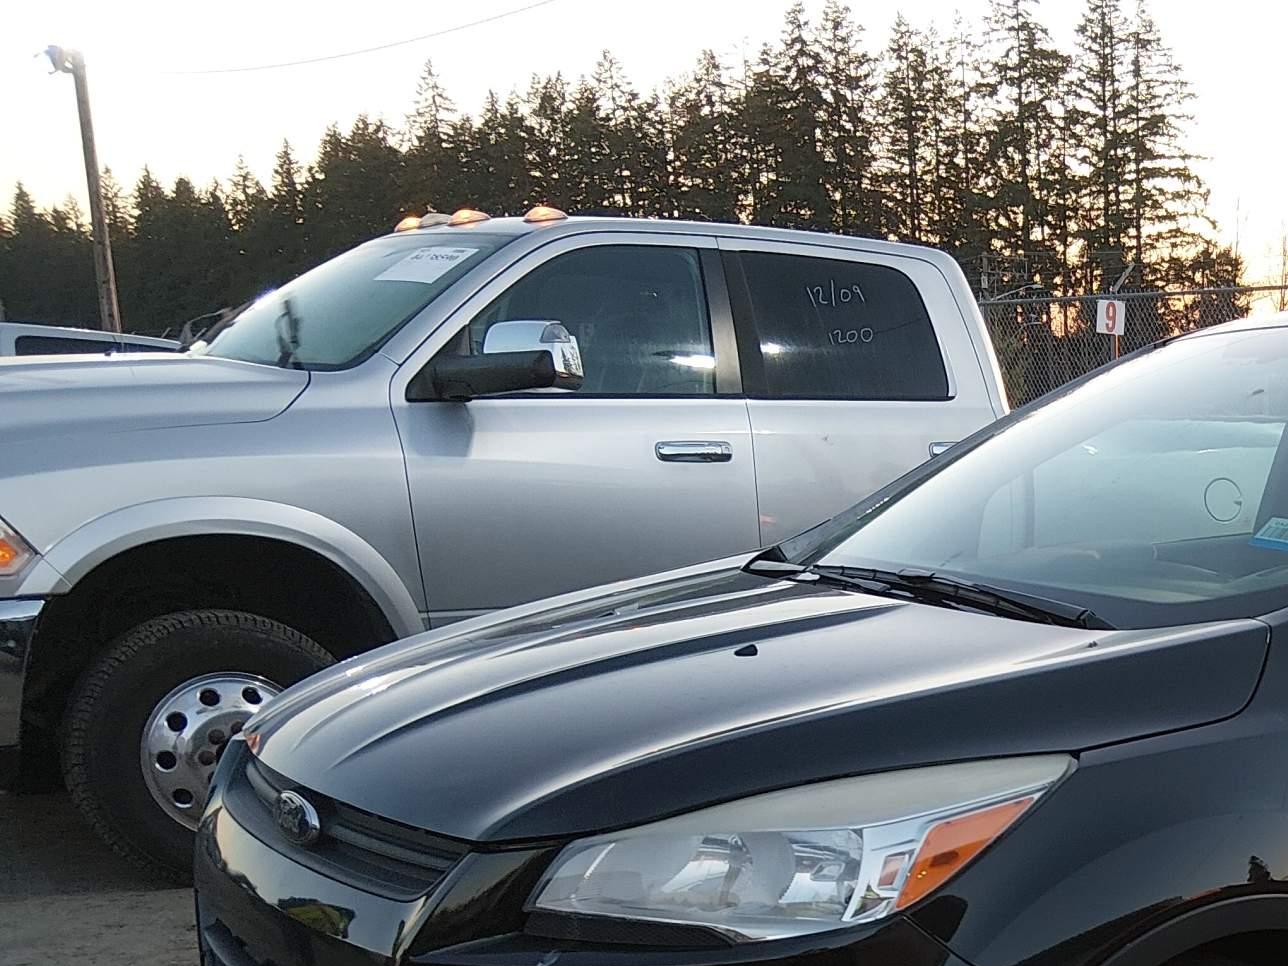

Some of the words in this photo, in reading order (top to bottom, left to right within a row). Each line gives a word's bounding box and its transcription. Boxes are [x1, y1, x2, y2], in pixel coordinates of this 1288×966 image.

[806, 279, 865, 308] 12/09
[1105, 301, 1118, 332] 9
[828, 327, 873, 346] 1200
